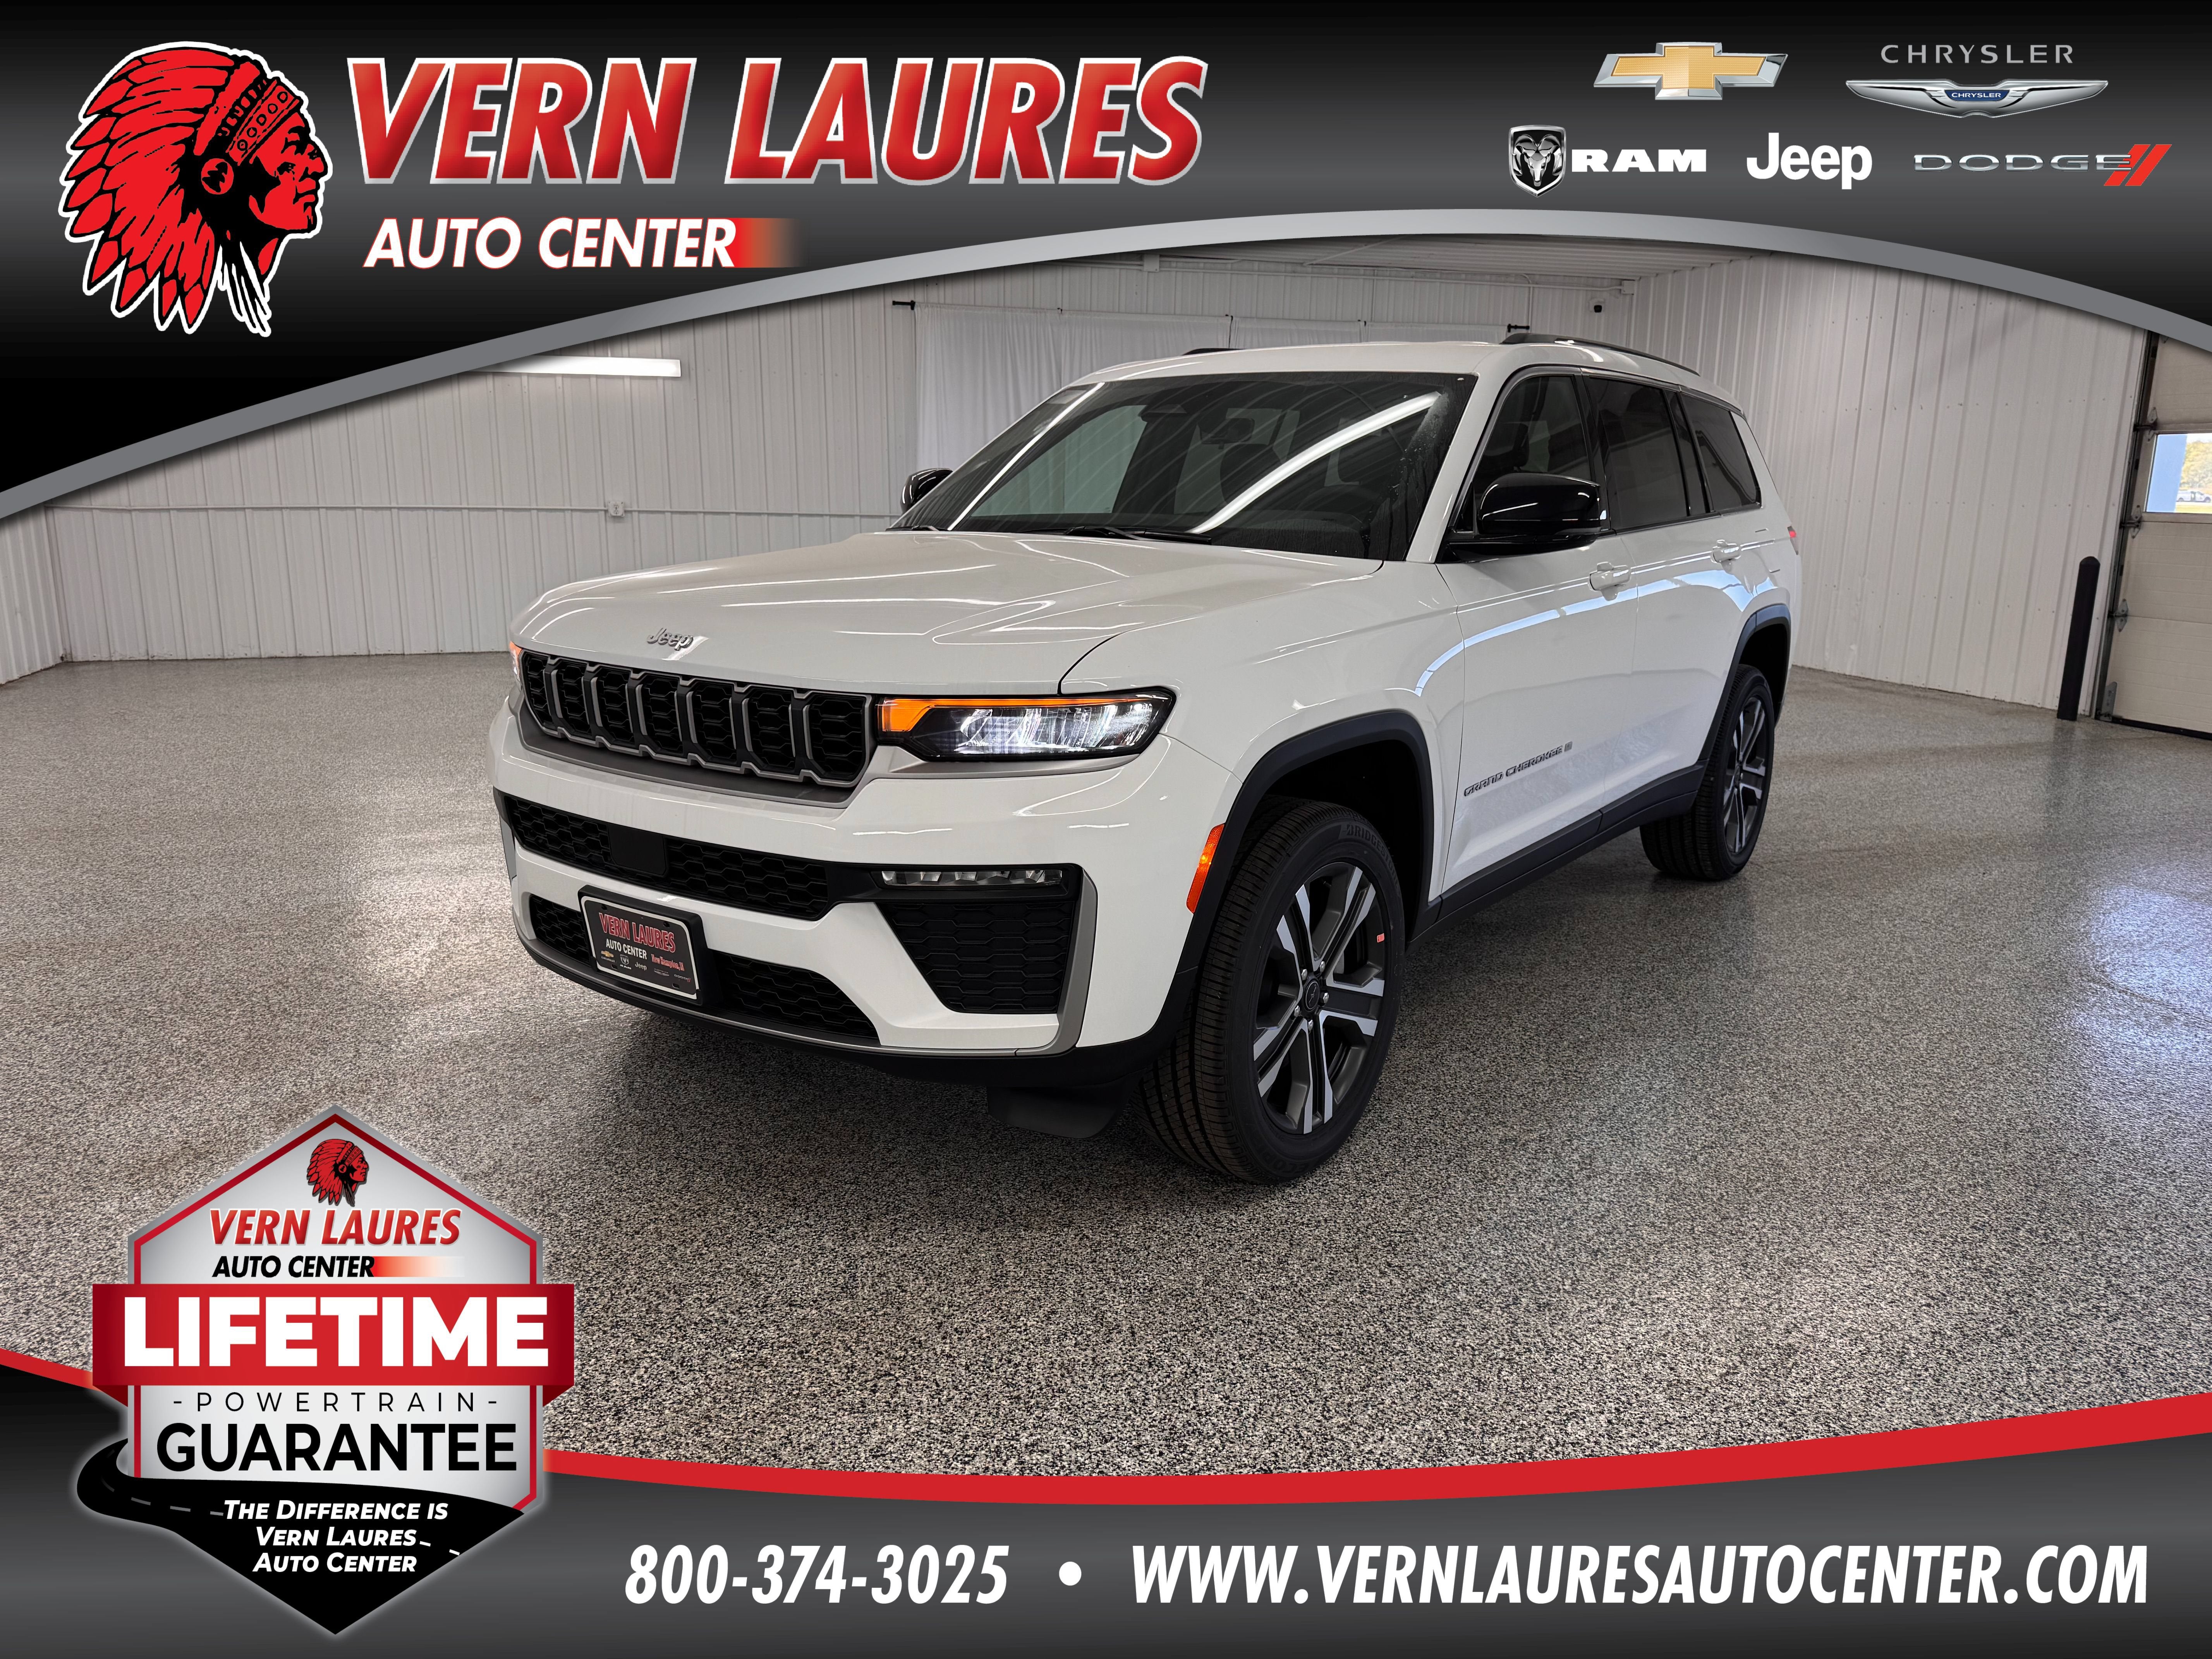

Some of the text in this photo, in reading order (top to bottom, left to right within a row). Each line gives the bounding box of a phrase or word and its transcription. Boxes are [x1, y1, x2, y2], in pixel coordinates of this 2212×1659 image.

[647, 627, 694, 651] Jeep
[1464, 745, 1563, 797] GRAND CHEROKEE
[598, 912, 676, 953] VERN LAURES
[606, 938, 622, 952] AUTO
[623, 943, 647, 960] CENTER
[635, 962, 647, 971] Jeep
